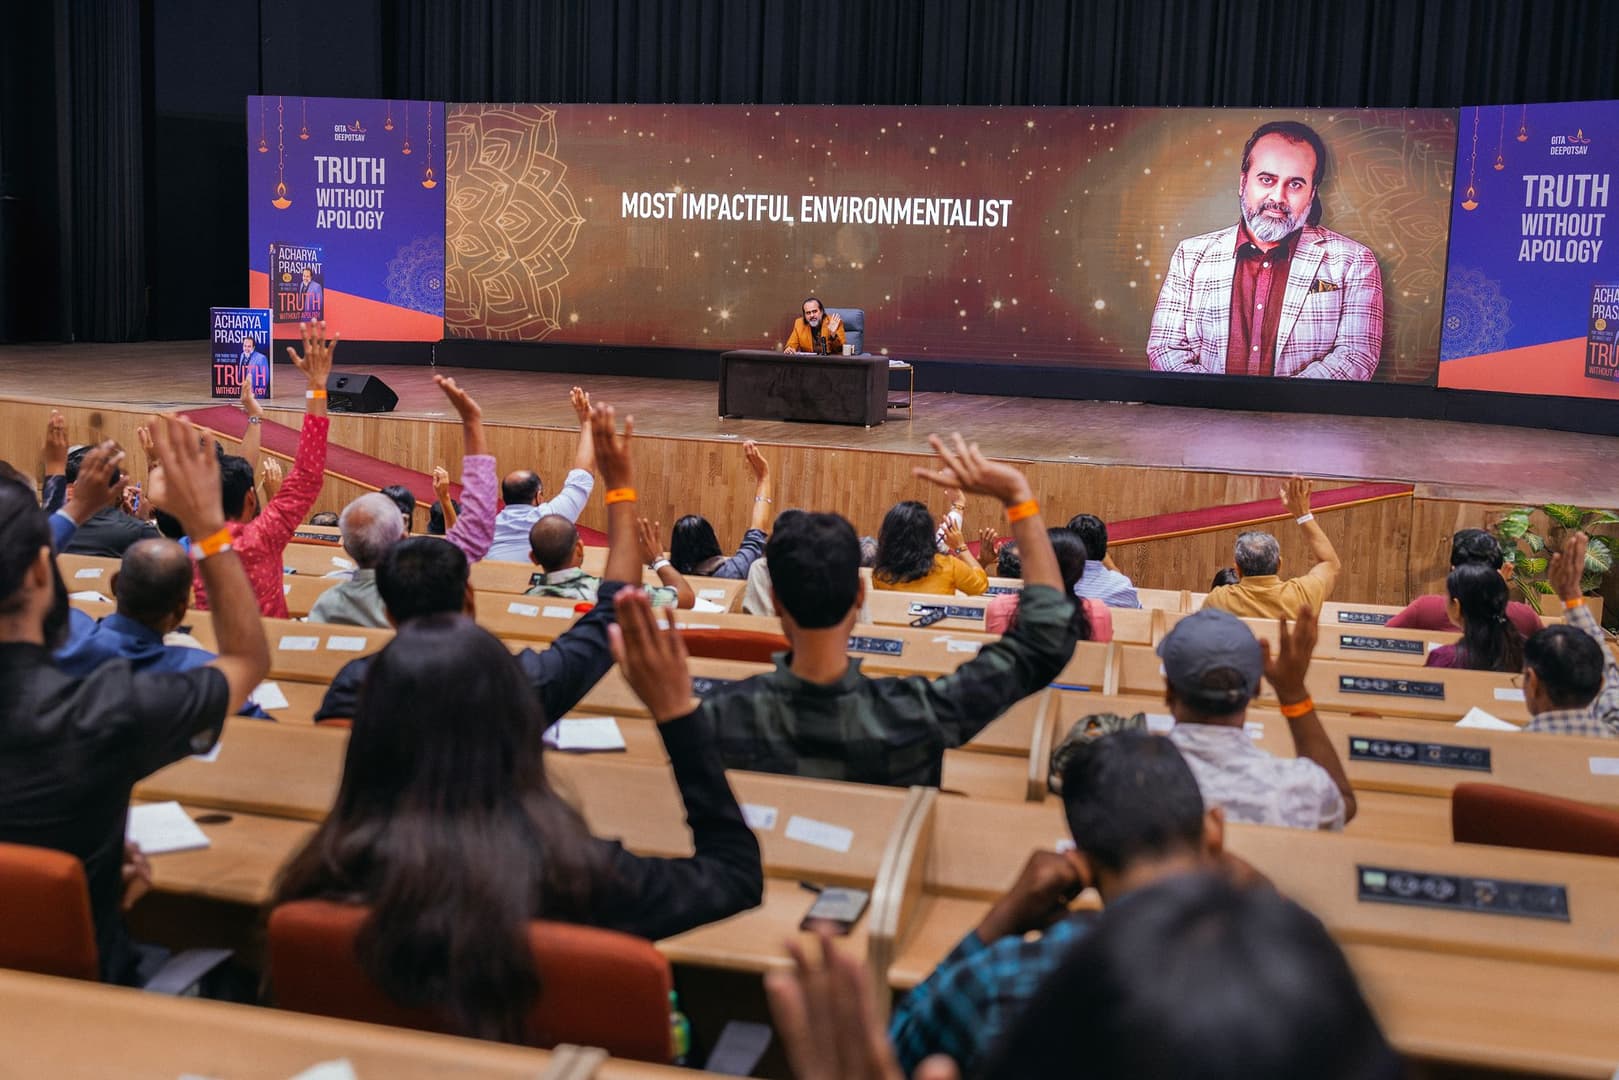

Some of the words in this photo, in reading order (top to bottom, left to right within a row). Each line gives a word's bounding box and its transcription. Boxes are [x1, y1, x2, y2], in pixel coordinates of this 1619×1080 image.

[334, 124, 347, 133] GITA
[334, 133, 365, 142] DEEPOTSAV
[1551, 136, 1566, 145] GITA
[1550, 146, 1588, 156] DEEPOTSAV
[314, 156, 385, 185] TRUTH
[316, 188, 385, 209] WITHOUT
[1522, 174, 1610, 208] TRUTH
[621, 192, 676, 219] MOST
[681, 193, 794, 223] IMPACTFUL
[801, 195, 1013, 227] ENVIRONMENTALIST
[316, 210, 385, 230] APOLOGY
[1521, 213, 1606, 237] WITHOUT
[278, 247, 318, 262] ACHARYA
[1518, 239, 1603, 264] APOLOGY
[278, 260, 322, 275] PRASHANT
[278, 292, 321, 312] TRUTH
[1592, 304, 1619, 320] PRAS
[214, 315, 261, 329] ACHARYA
[214, 329, 268, 344] PRASHANT
[215, 386, 240, 395] WITHOUT
